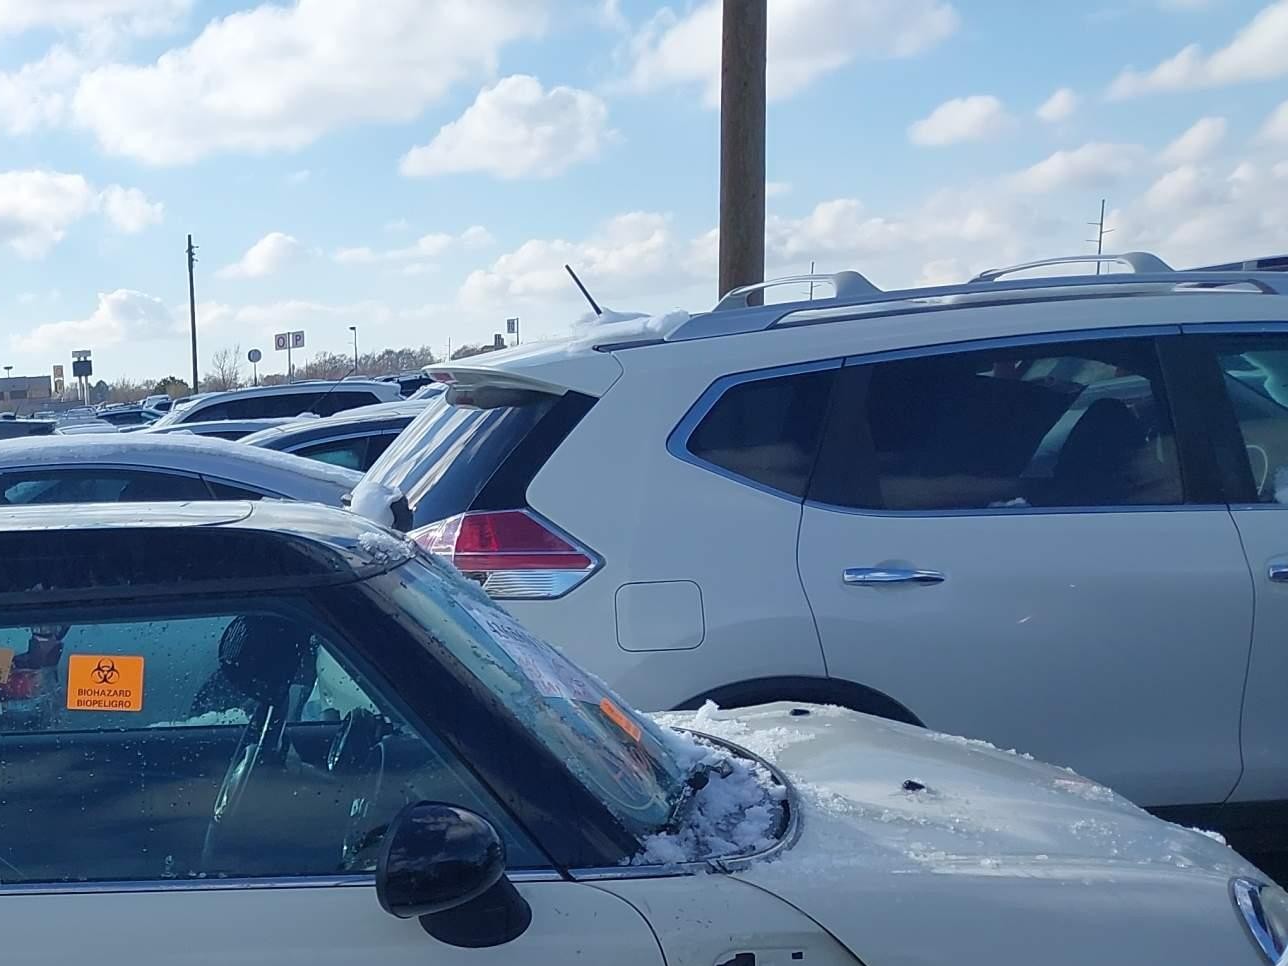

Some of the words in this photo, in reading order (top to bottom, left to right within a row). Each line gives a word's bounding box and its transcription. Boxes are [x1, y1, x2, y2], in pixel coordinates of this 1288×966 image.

[295, 334, 302, 346] P
[77, 688, 132, 697] BIOHAZARD
[76, 699, 132, 708] BIOPELIGRO
